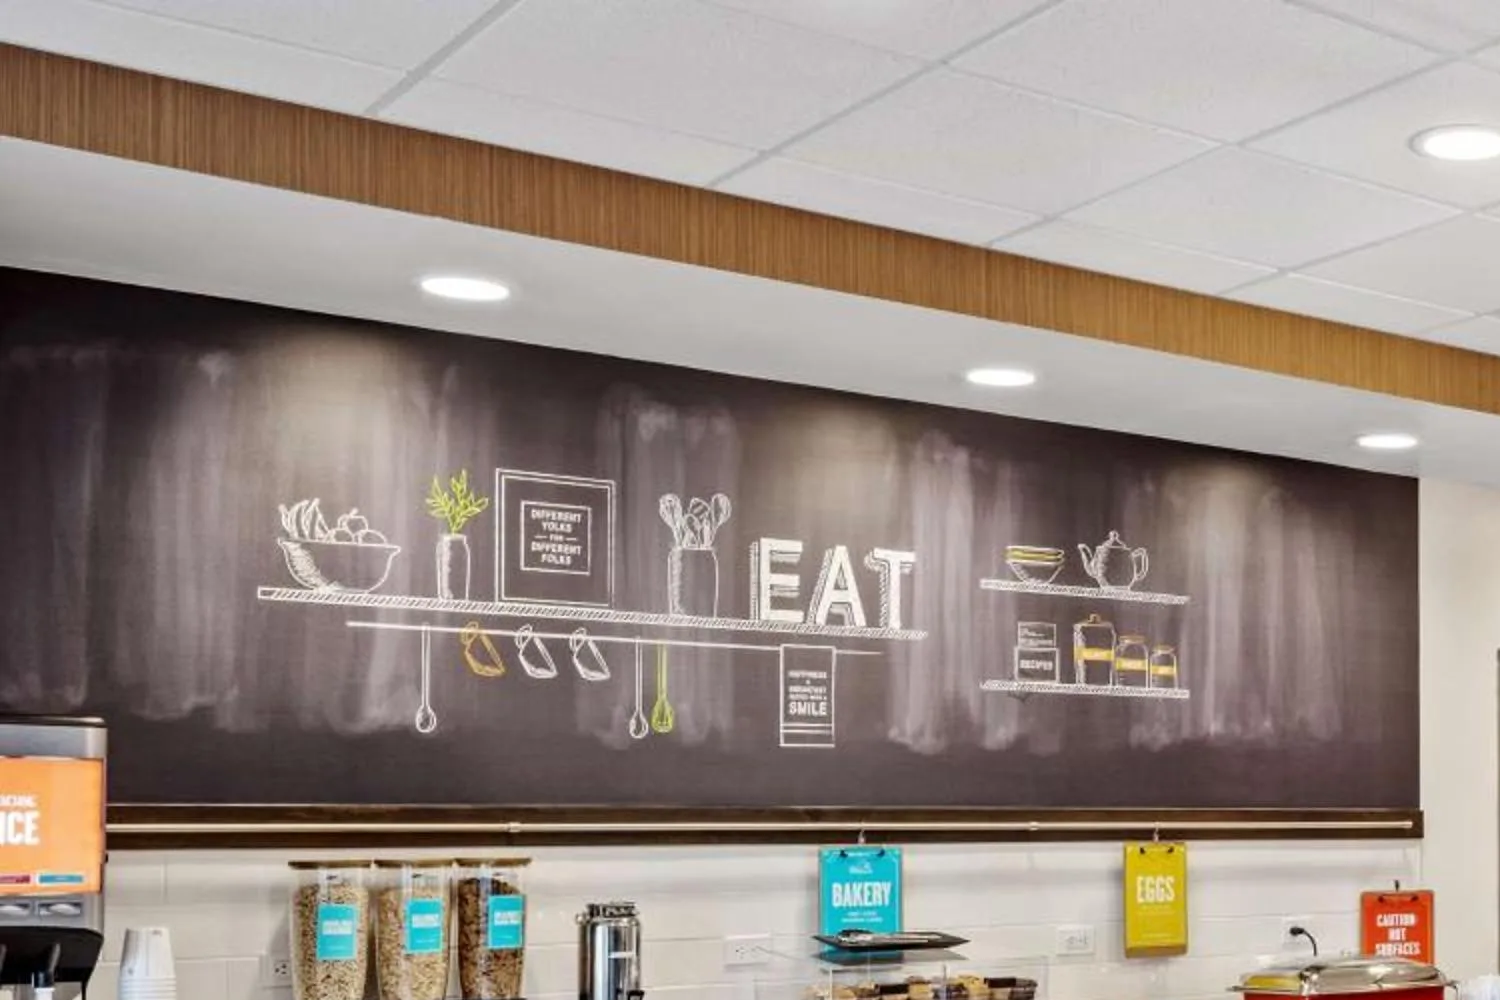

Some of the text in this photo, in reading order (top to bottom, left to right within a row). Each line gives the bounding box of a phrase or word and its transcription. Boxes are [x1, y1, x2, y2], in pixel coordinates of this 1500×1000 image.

[531, 508, 581, 523] DIFFERENT
[542, 521, 572, 533] YOLKS
[531, 541, 582, 556] DIFFERENT
[541, 554, 571, 566] FOLKS
[751, 537, 917, 630] EAT
[789, 701, 827, 717] SMILE
[832, 881, 891, 907] BAKERY
[1137, 876, 1175, 903] EGGS
[1388, 928, 1407, 941] HOT
[1375, 941, 1422, 956] SURFACES
